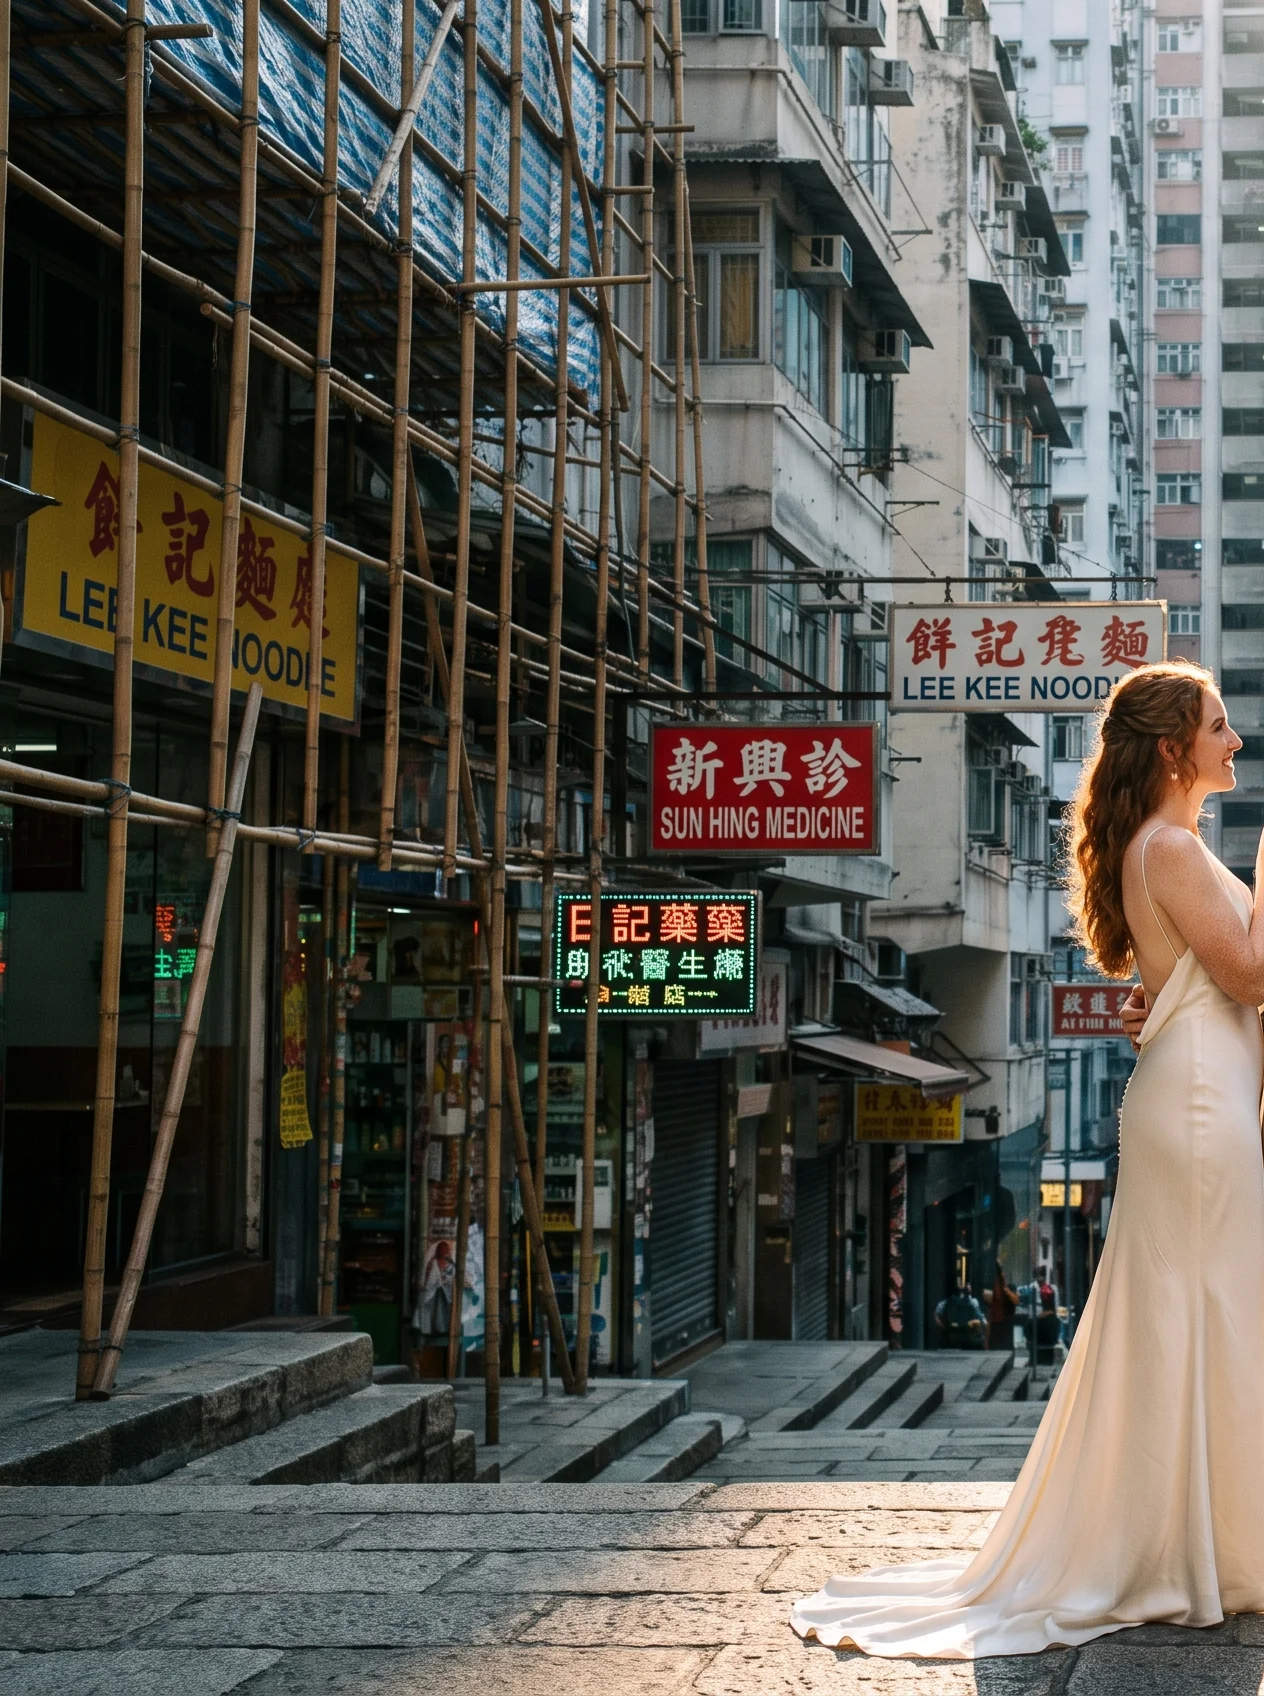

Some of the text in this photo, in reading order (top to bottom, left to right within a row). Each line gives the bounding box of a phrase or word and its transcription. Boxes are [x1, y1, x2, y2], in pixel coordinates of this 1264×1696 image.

[142, 598, 209, 661] KEE
[903, 675, 1120, 700] LEE KEE NOOD
[660, 806, 865, 839] SUN HING MEDICINE
